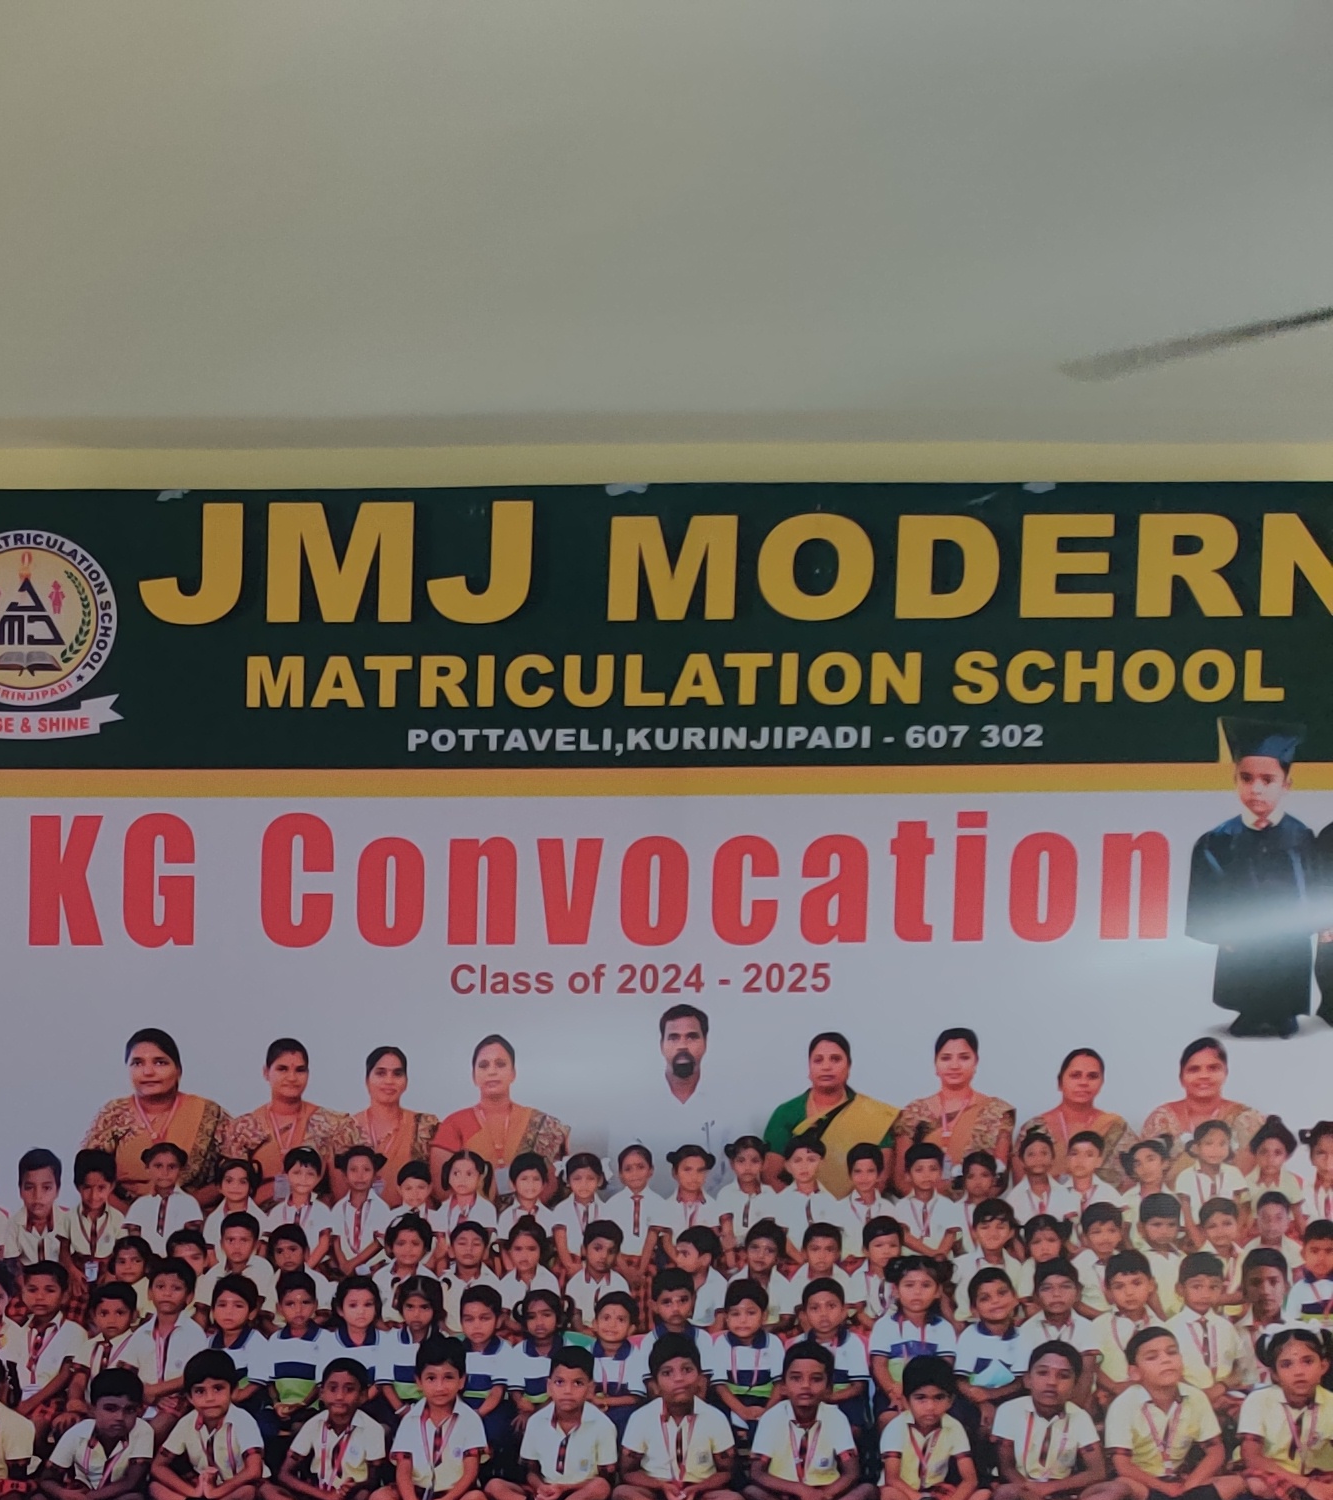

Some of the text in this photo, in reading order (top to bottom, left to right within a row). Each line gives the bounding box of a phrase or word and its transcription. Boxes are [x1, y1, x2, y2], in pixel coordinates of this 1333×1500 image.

[140, 502, 1333, 624] JMJ MODERN
[82, 600, 113, 673] SCHOOL
[247, 650, 1284, 707] MATRICULATION SCHOOL
[20, 718, 32, 734] &
[37, 717, 91, 733] SHINE
[408, 726, 870, 755] POTTAVELI,KURINJIPADI
[906, 726, 969, 748] 607
[981, 725, 1043, 747] 302
[28, 811, 1170, 948] KG Convocation
[450, 963, 554, 995] Class
[567, 963, 607, 995] of
[617, 962, 705, 995] 2024
[742, 961, 831, 994] 2025
